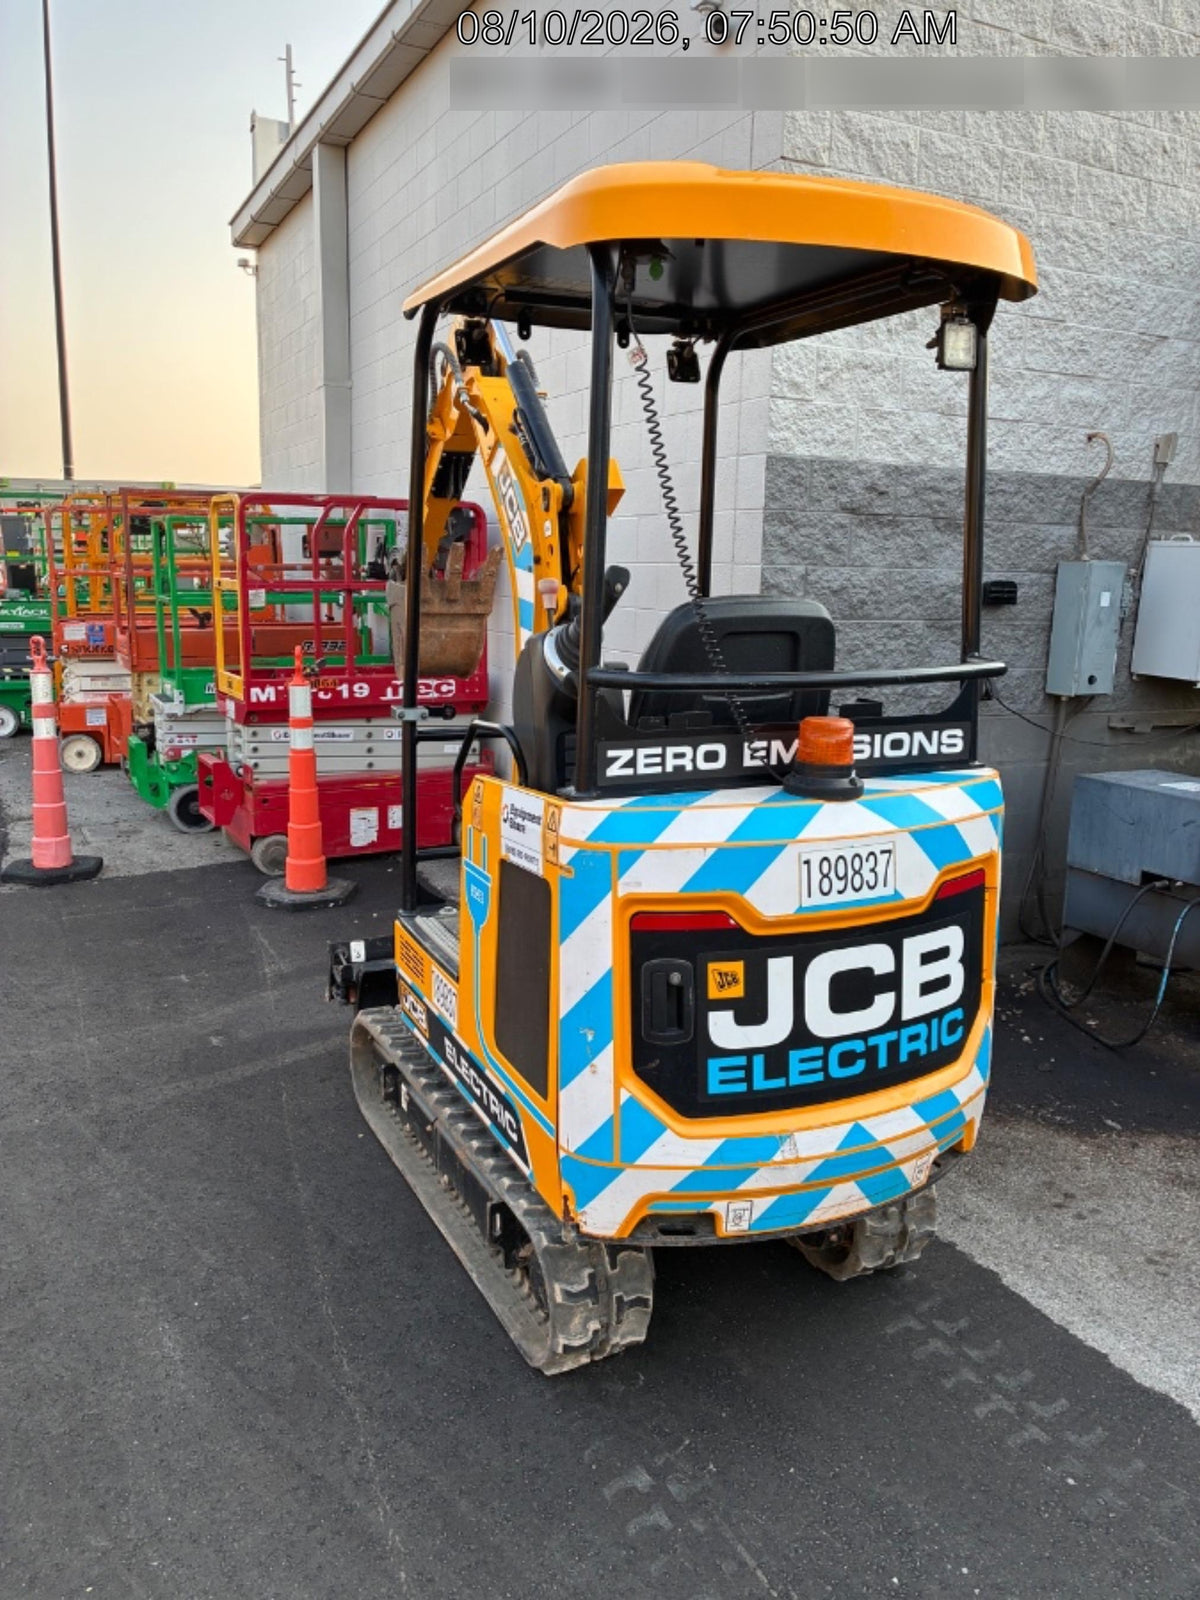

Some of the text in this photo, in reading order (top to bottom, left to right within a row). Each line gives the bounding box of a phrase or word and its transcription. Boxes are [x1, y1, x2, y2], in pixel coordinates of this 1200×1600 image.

[498, 474, 527, 549] JCB
[605, 728, 965, 777] ZERO EMSIONS
[803, 849, 892, 898] 189837
[707, 925, 965, 1050] JCB
[717, 971, 739, 990] JCB
[707, 1007, 965, 1094] ELECTRIC
[444, 1036, 518, 1143] ELECTRIC
